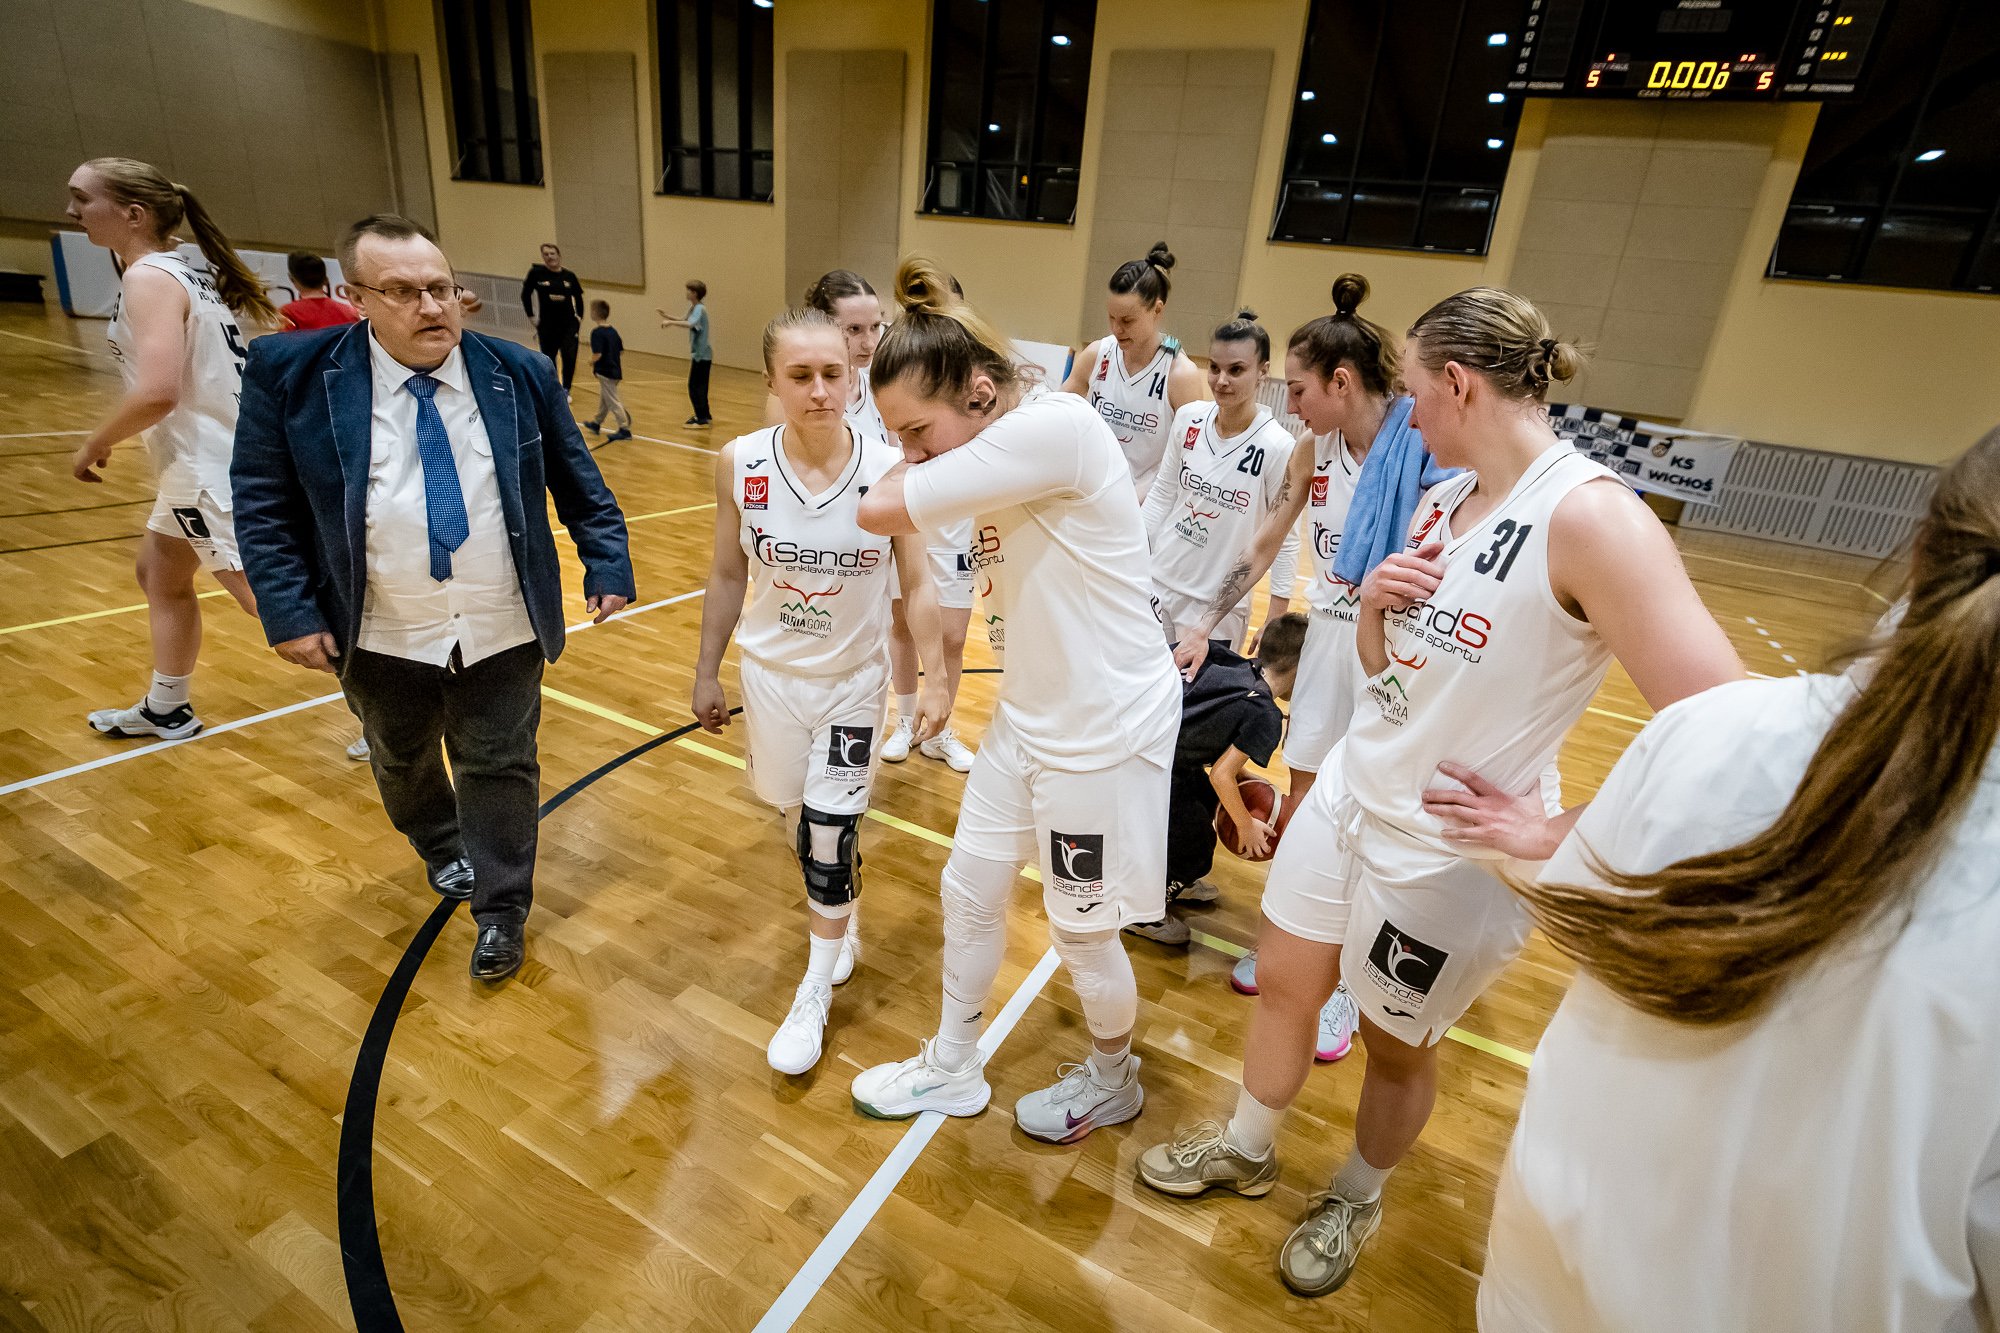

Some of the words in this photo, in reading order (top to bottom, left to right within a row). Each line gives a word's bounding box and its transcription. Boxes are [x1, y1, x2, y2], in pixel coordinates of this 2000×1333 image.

[1148, 372, 1166, 400] 14
[1098, 400, 1159, 428] iSandS
[1236, 443, 1265, 477] 20
[1670, 455, 1696, 470] KS
[1649, 469, 1714, 492] WICHOŚ
[765, 541, 880, 568] iSandS
[1474, 518, 1533, 582] 31
[785, 565, 835, 576] enklawa
[1425, 632, 1482, 664] sportu
[825, 766, 869, 777] iSandS
